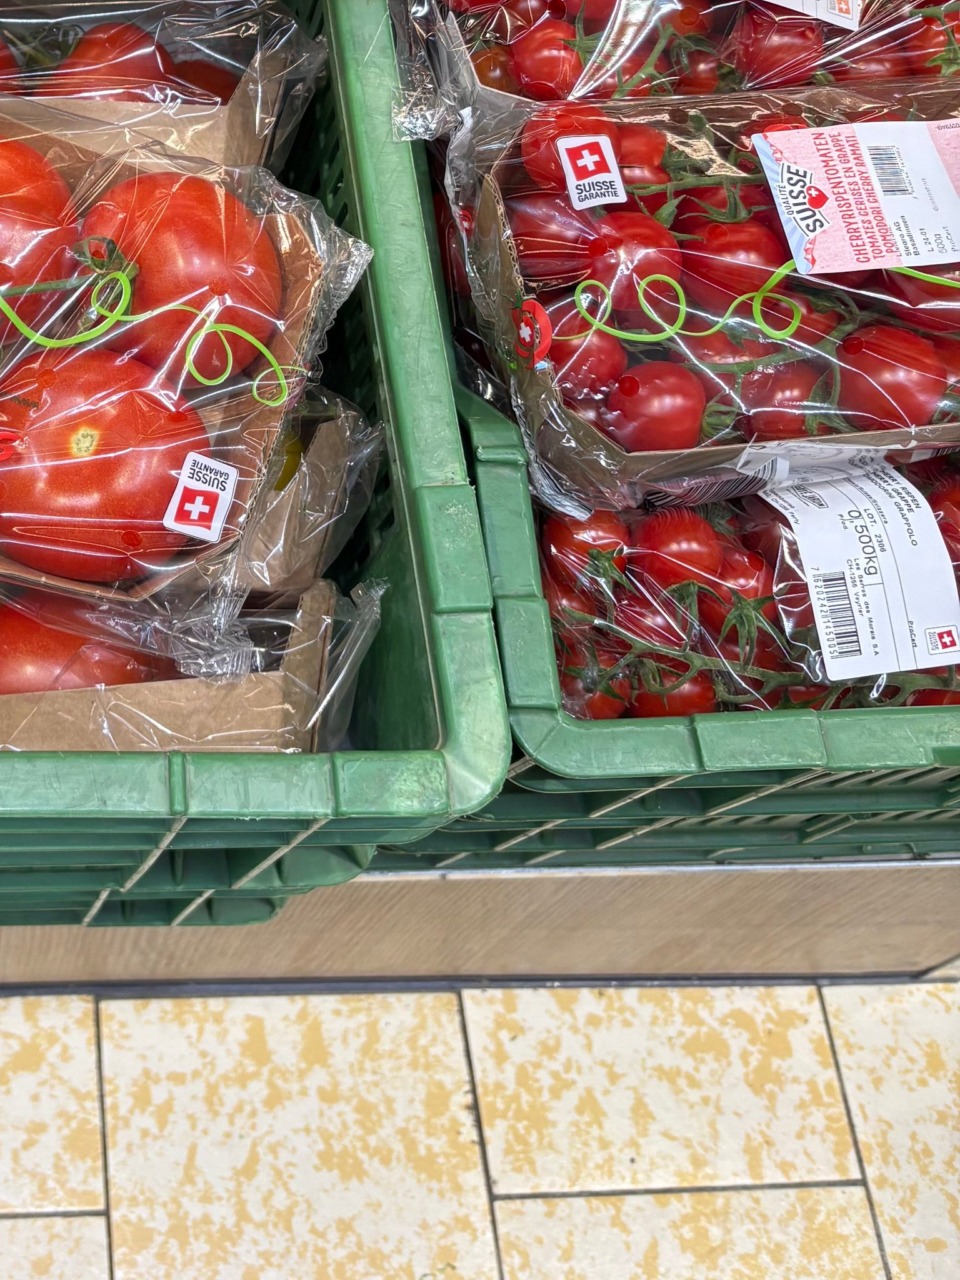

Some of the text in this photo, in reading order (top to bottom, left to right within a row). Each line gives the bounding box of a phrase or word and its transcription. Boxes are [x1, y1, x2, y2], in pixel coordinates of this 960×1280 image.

[575, 180, 617, 195] SUISSE
[577, 191, 620, 203] GARANTIE
[777, 184, 794, 216] QUALITÉ
[786, 165, 825, 234] SUISSE
[811, 132, 871, 263] CHERRYRISPENTOMATEN
[829, 131, 885, 260] TOMATES CERISES EN GRAPPE
[845, 135, 895, 254] POMODORI CHERRY RAMATI
[893, 221, 903, 232] AG
[187, 467, 228, 492] SUISSE
[191, 459, 230, 481] GARANTIE
[862, 473, 895, 499] OMODORINI
[893, 501, 919, 547] GRAPPOLO
[891, 483, 916, 514] GRAPPE
[901, 486, 923, 509] RISPEN
[847, 509, 879, 576] 0,500kg
[863, 508, 887, 553] LOT. 2306
[853, 590, 865, 617] Veyrier
